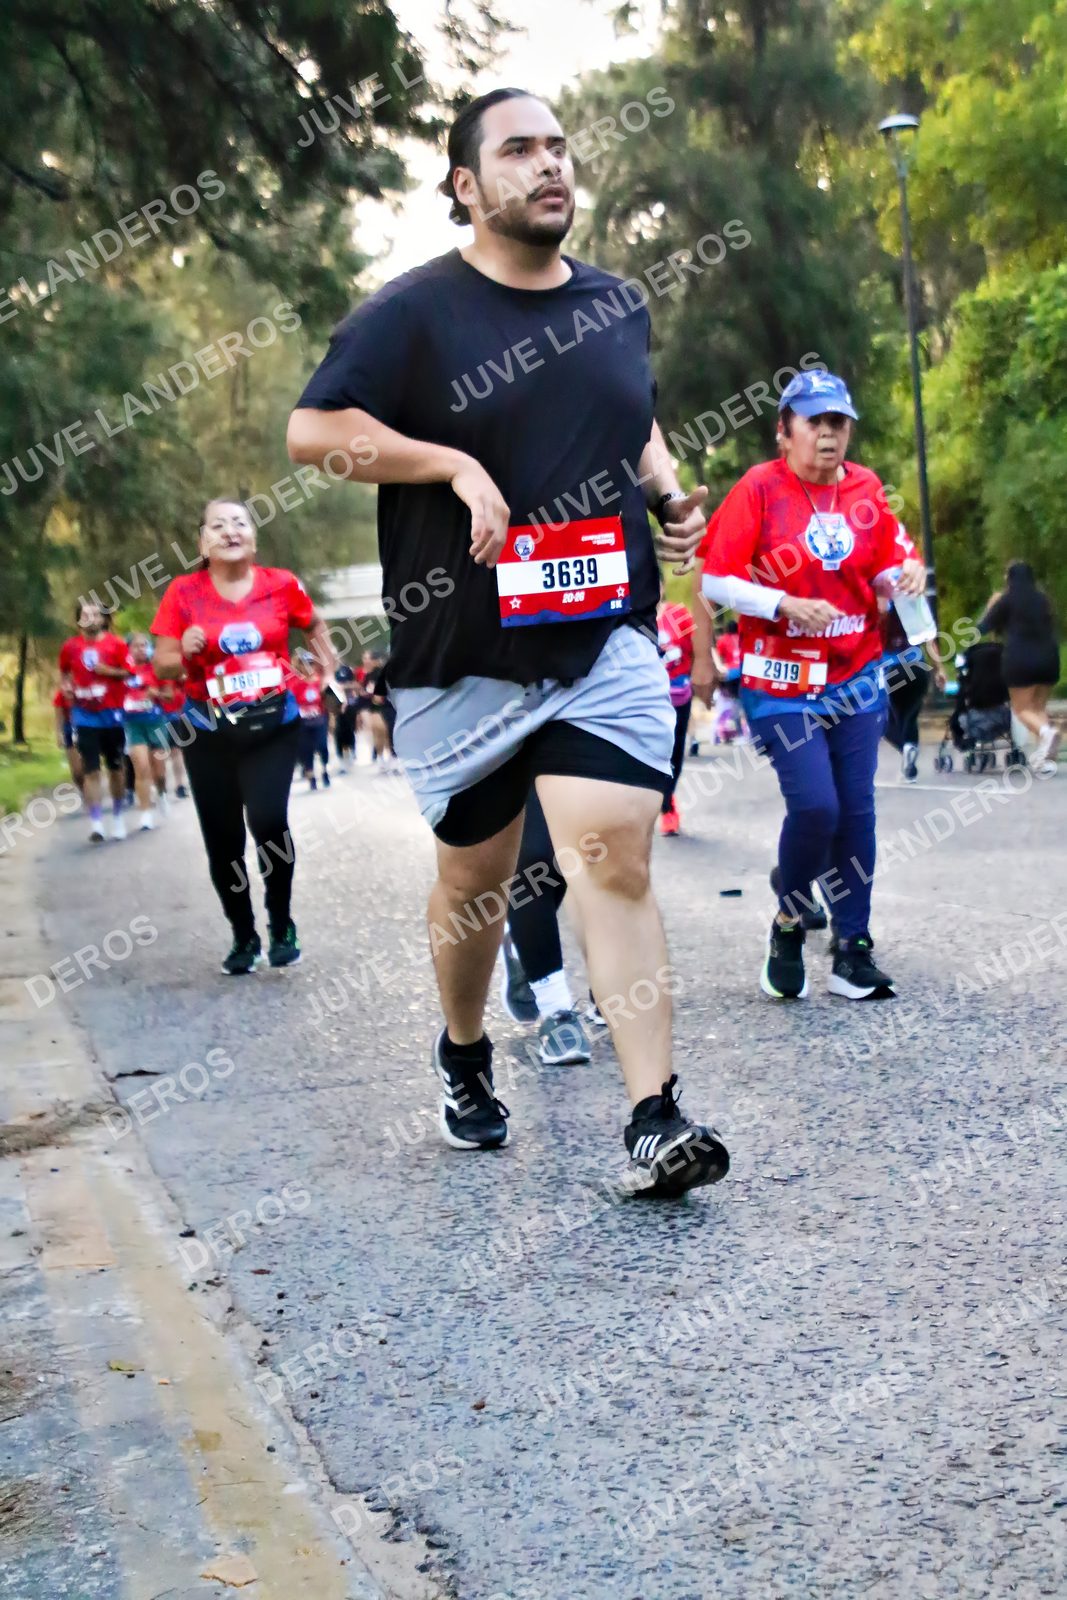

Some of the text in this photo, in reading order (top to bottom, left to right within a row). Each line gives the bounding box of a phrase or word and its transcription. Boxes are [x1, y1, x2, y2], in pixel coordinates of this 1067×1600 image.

[542, 558, 598, 589] 3639
[786, 614, 865, 637] STIAGO
[763, 660, 799, 681] 2919
